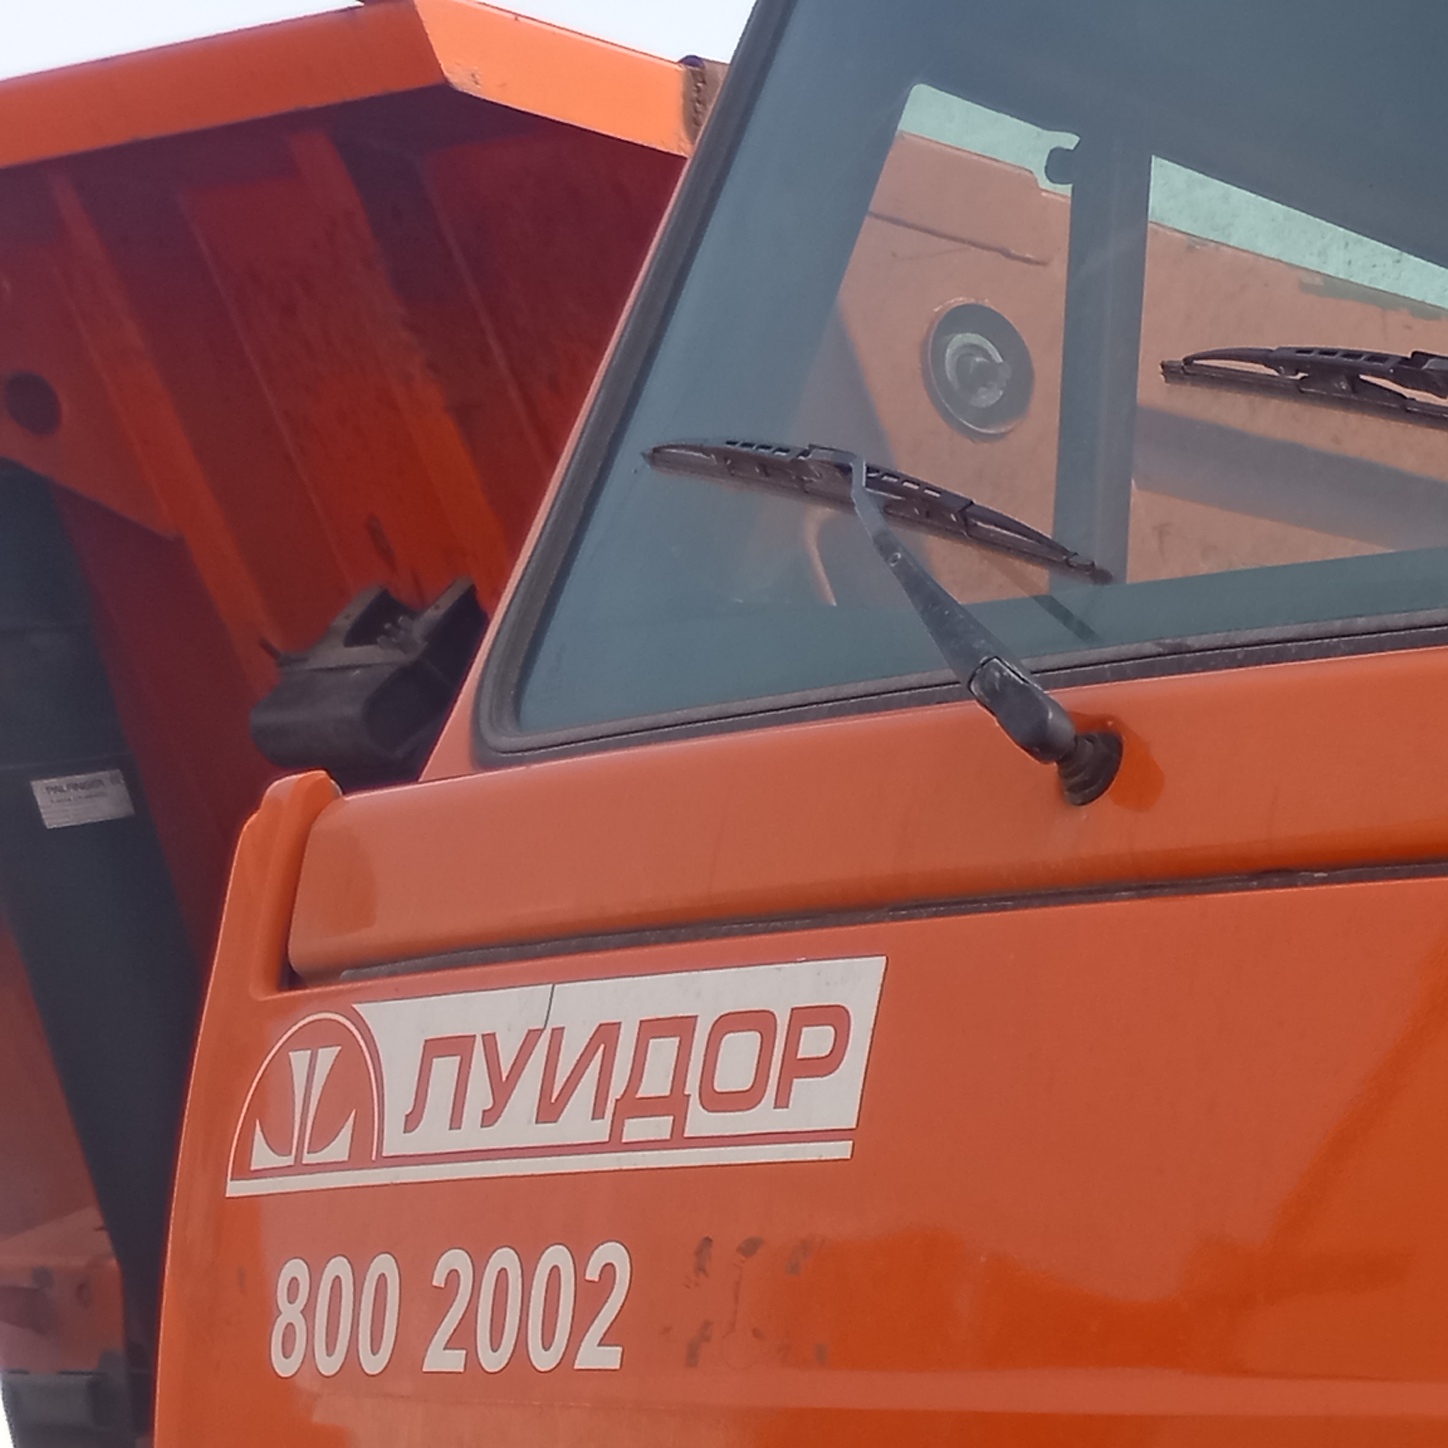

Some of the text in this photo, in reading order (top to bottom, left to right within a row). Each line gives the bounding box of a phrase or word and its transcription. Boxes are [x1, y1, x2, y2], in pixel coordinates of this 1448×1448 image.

[403, 1003, 851, 1143] ЛУИДОР
[270, 1240, 632, 1378] 800 2002
